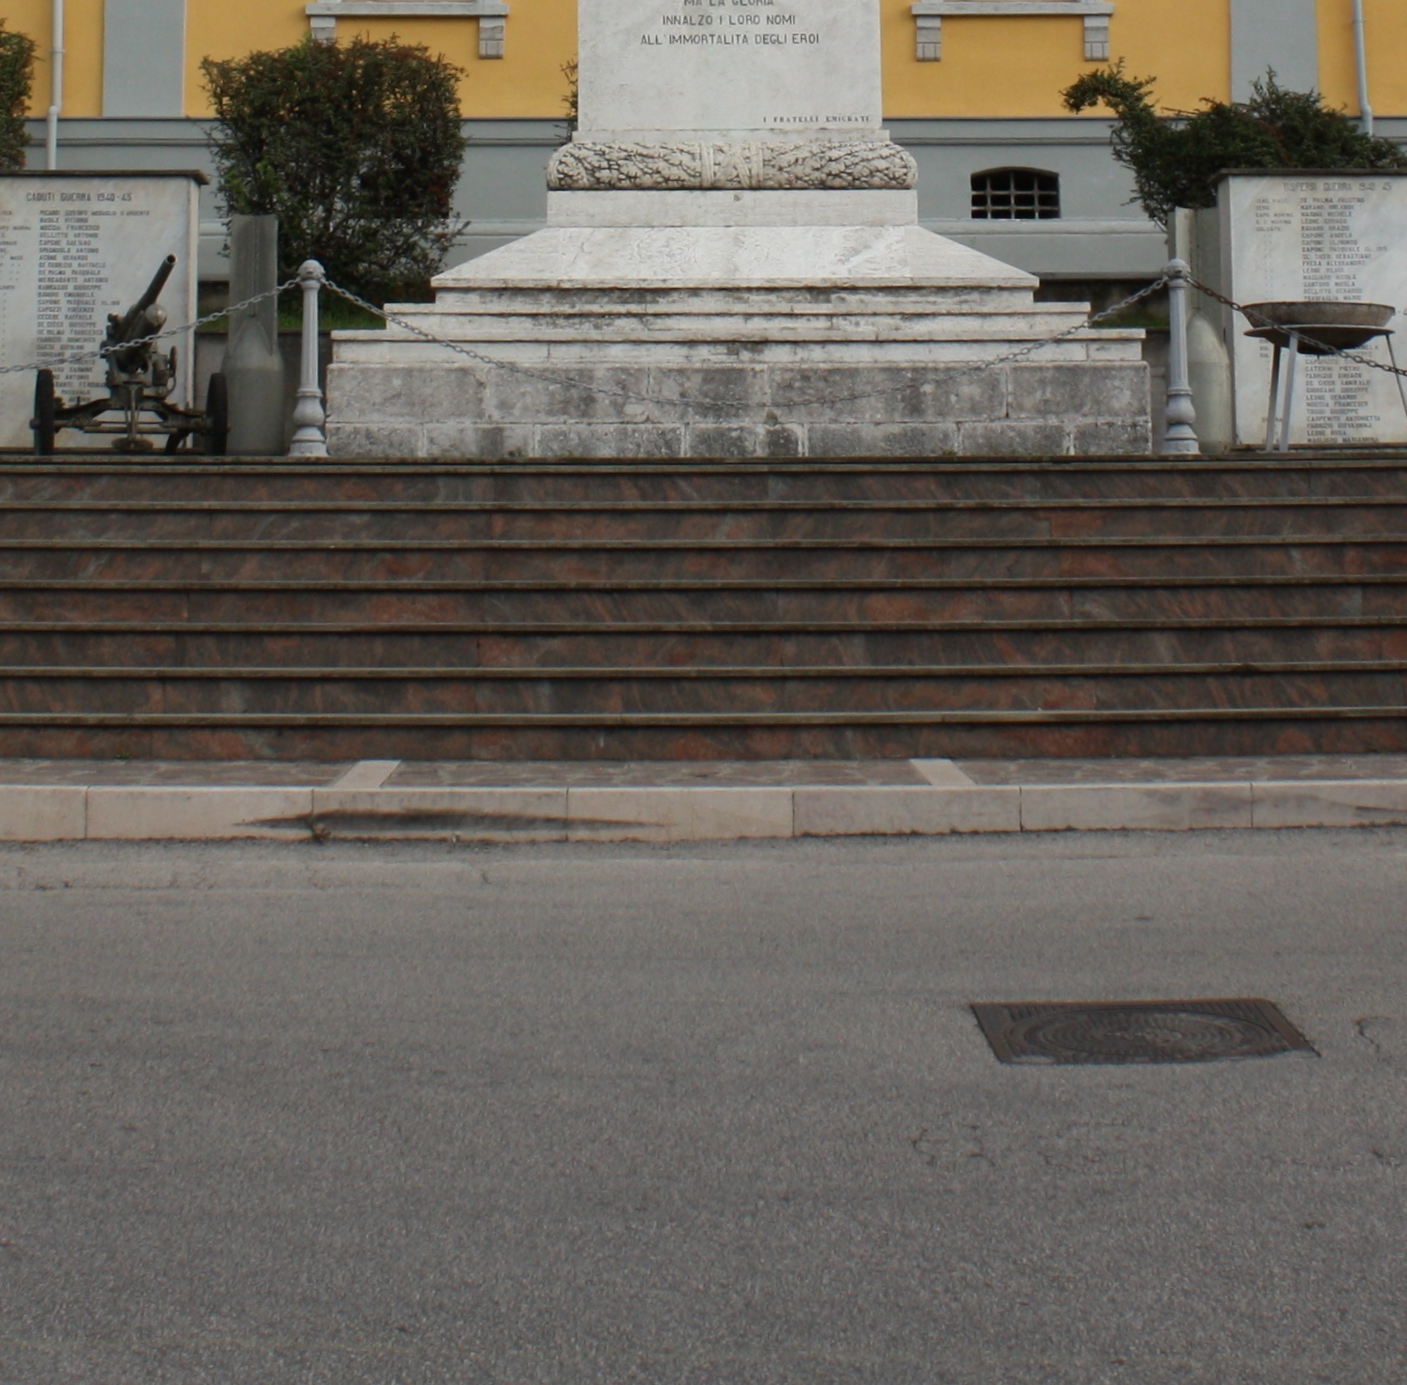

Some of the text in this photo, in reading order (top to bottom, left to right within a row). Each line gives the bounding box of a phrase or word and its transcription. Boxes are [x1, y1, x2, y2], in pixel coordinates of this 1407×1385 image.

[719, 15, 723, 26] I
[729, 15, 761, 26] LORO
[766, 15, 796, 26] NOMI
[755, 34, 788, 45] DEGLI
[792, 33, 820, 44] EROI
[1323, 182, 1352, 192] GUERRA
[26, 192, 55, 202] CADUTI
[60, 192, 92, 202] GUERRA
